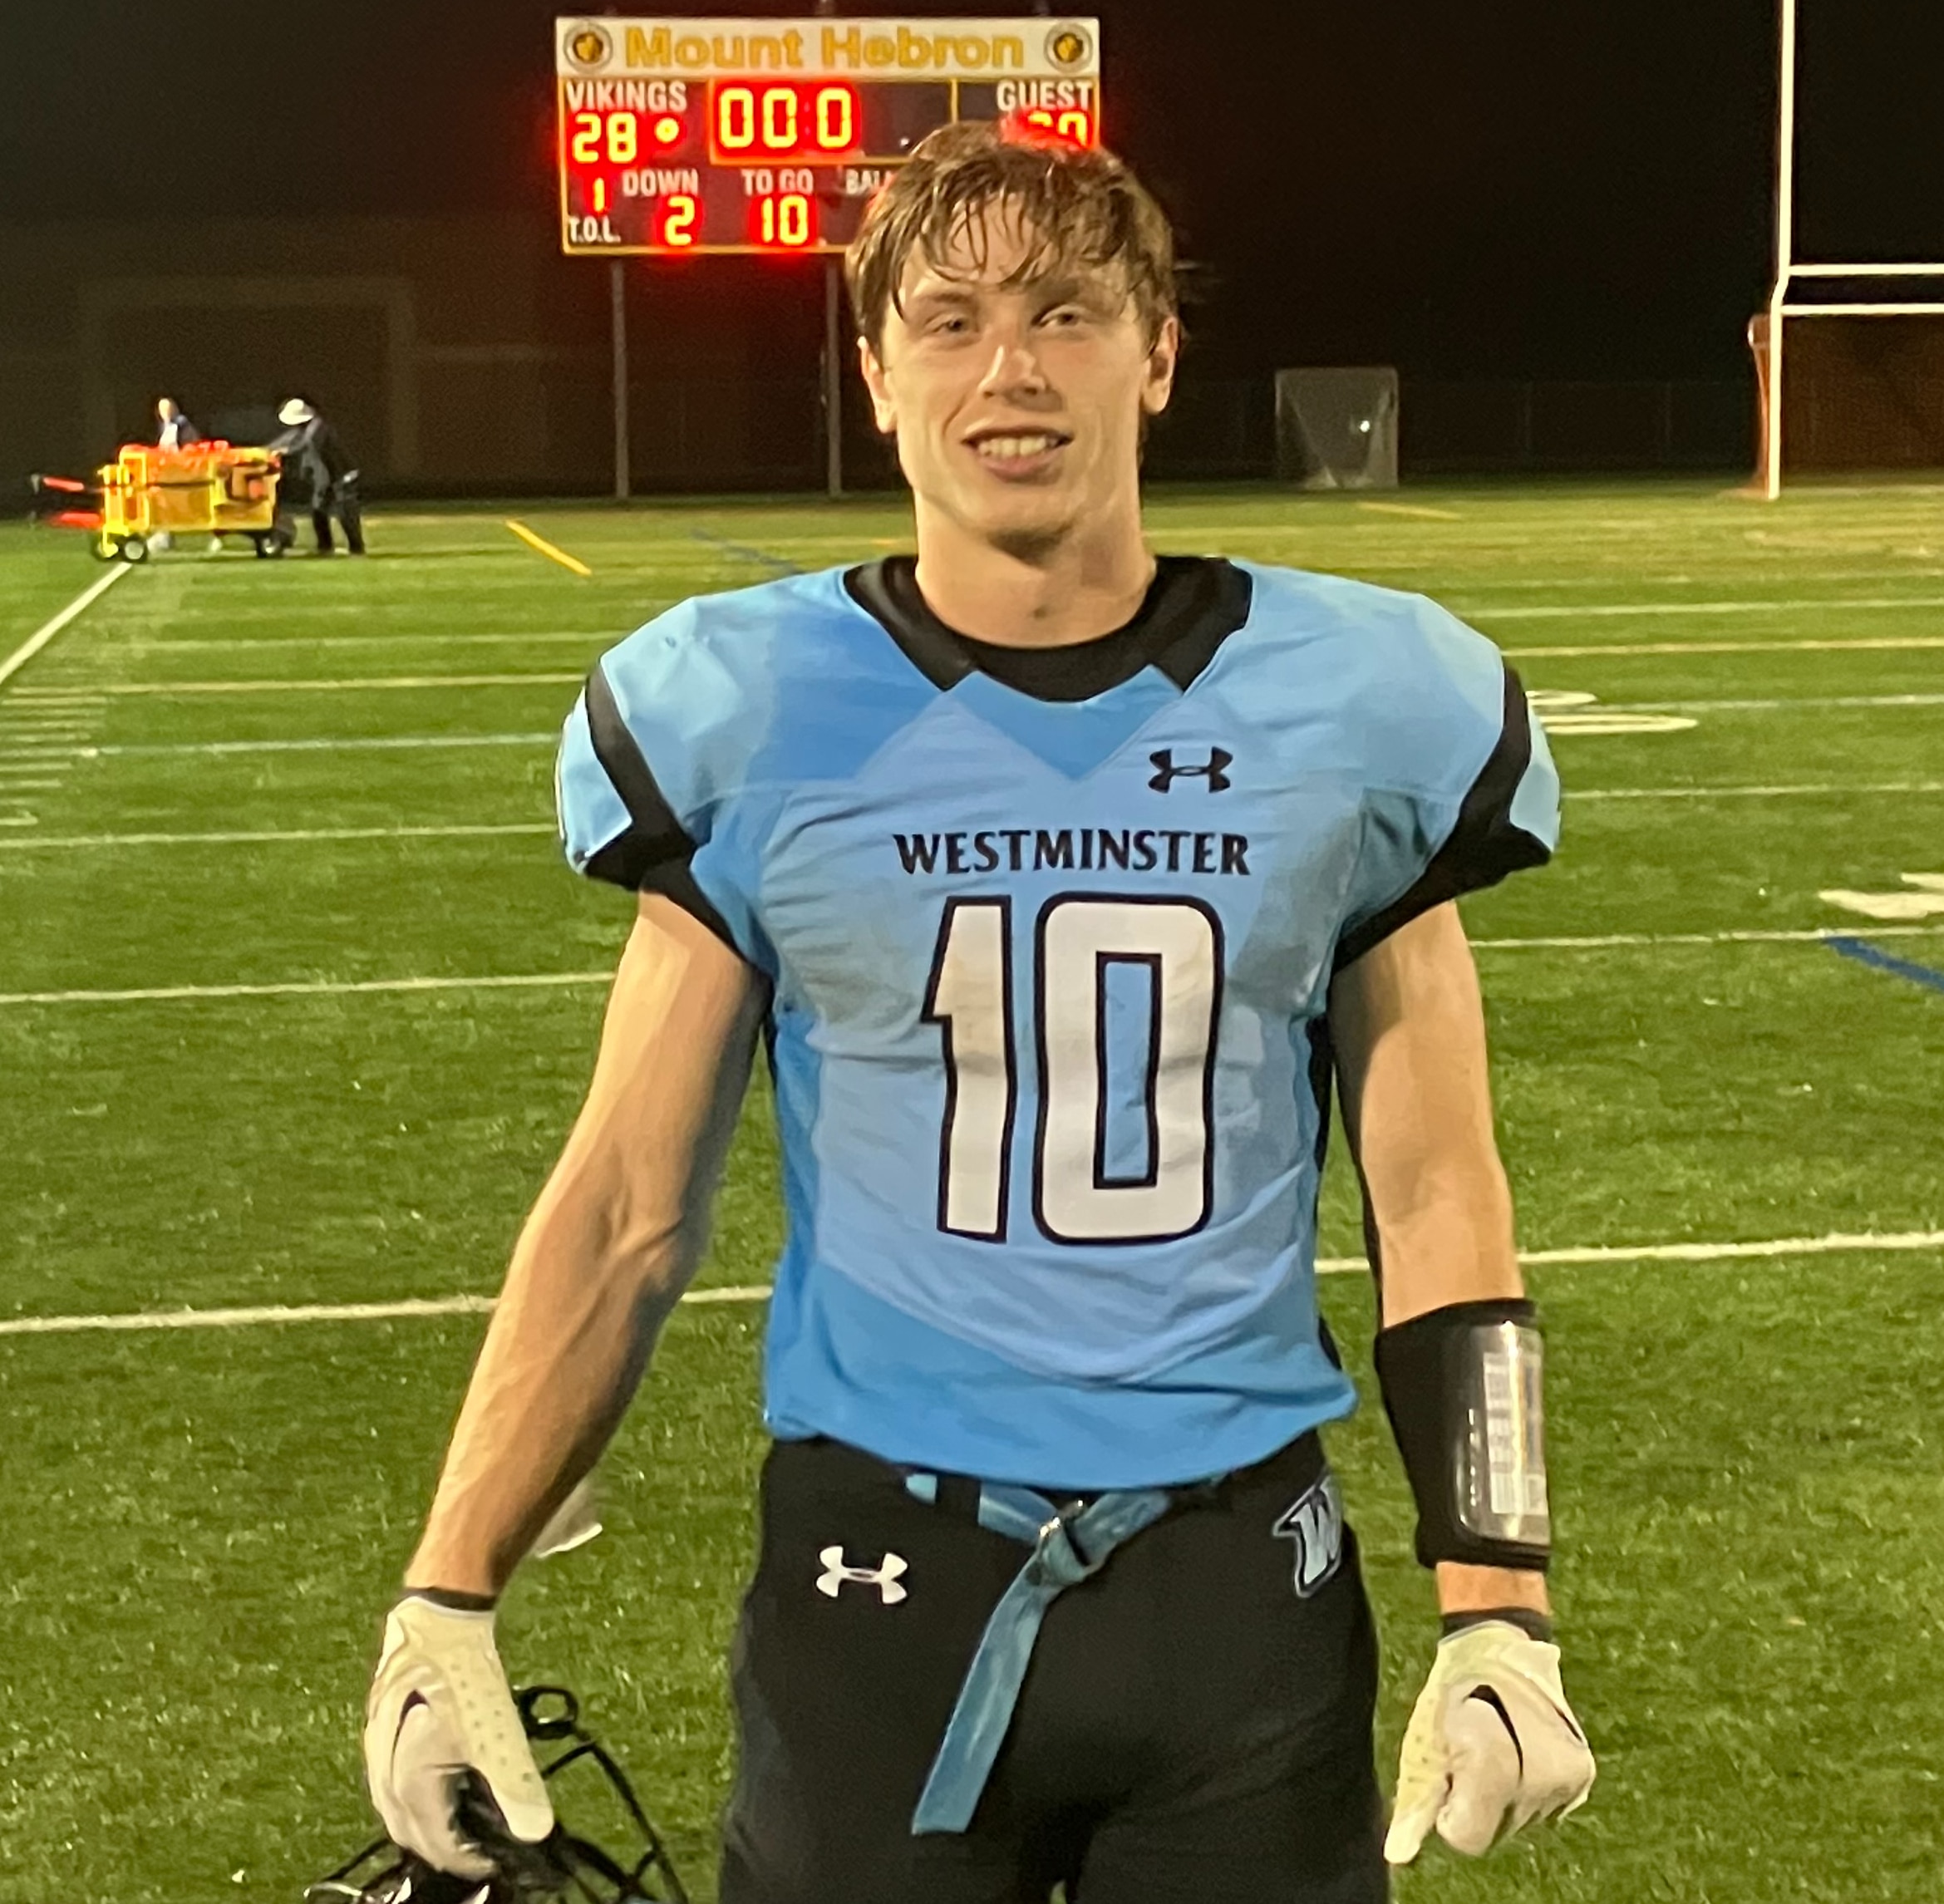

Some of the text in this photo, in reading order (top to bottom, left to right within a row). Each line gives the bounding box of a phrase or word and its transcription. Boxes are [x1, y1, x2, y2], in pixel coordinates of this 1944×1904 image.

[625, 26, 1024, 70] Mount Hebron
[567, 80, 687, 113] VIKINGS
[997, 79, 1093, 112] GUEST
[572, 112, 637, 163] 28
[593, 179, 606, 212] 1
[623, 170, 699, 197] DOWN
[741, 169, 814, 195] TO GO
[665, 196, 696, 246] 2
[761, 195, 809, 245] 10
[893, 829, 1251, 876] WESTMINSTER
[919, 891, 1224, 1247] 10
